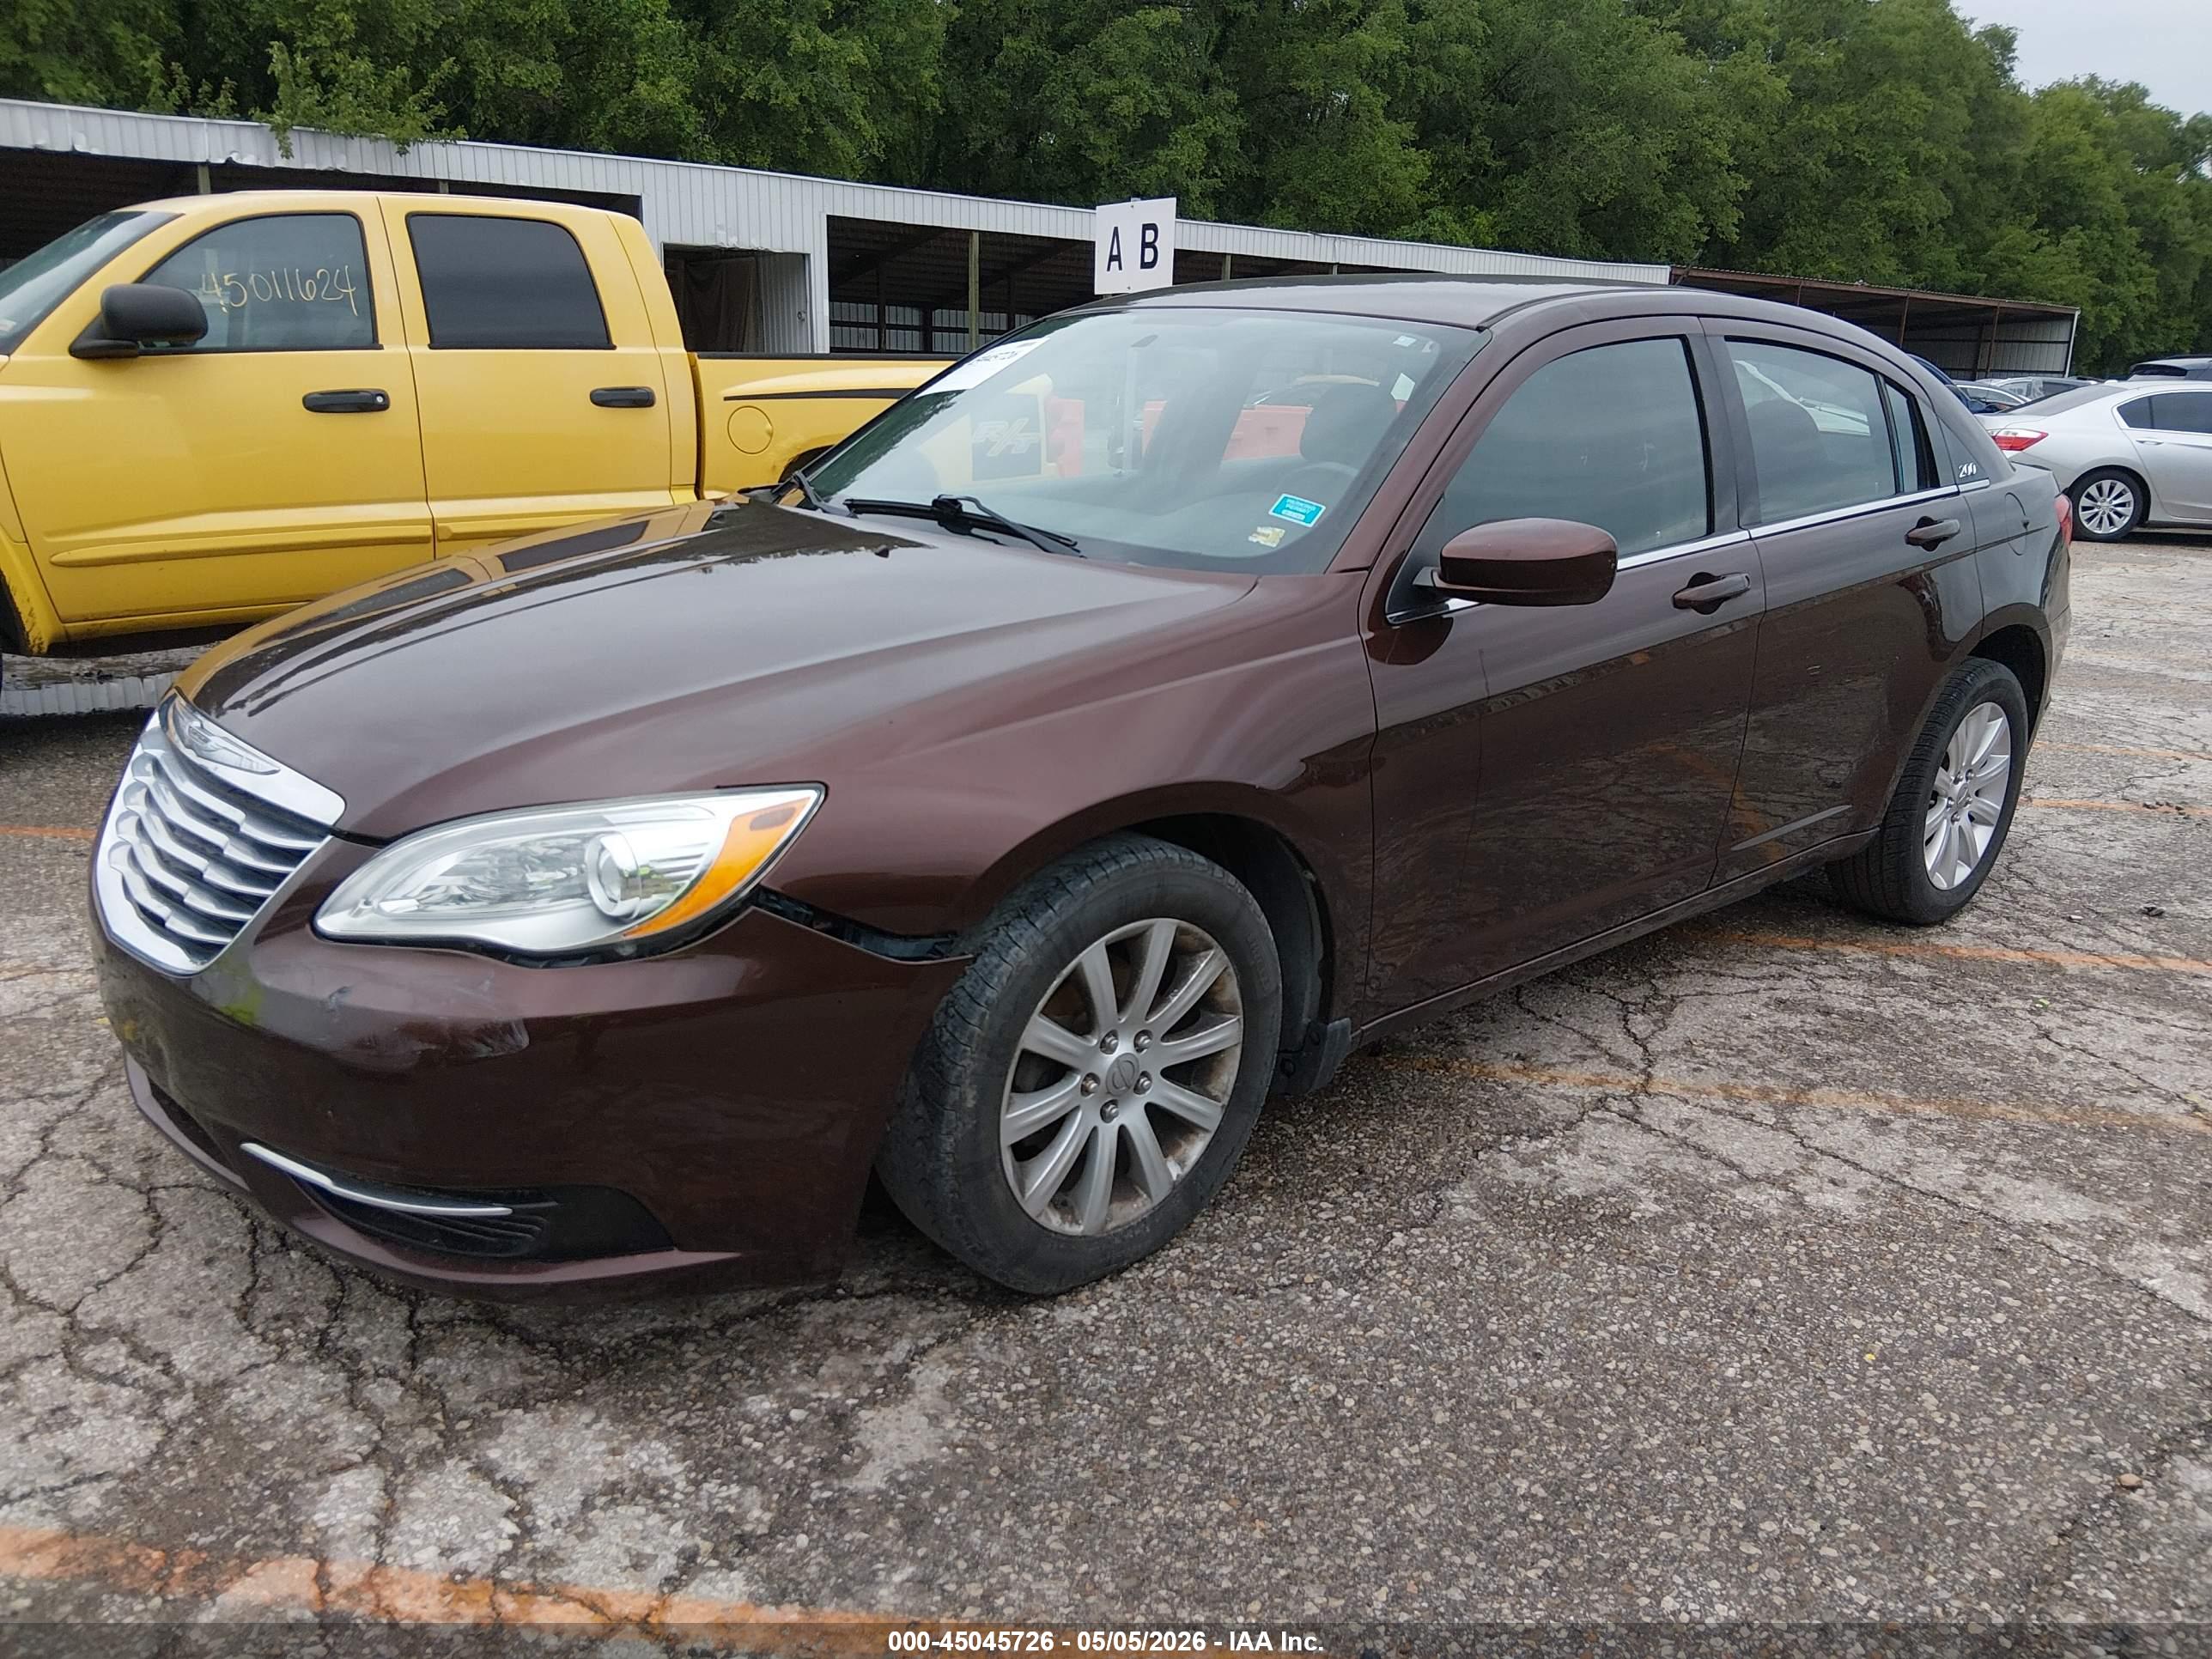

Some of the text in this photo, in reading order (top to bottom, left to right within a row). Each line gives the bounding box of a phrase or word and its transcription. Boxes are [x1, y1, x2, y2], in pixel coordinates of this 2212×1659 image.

[1106, 222, 1159, 272] A B
[200, 264, 359, 317] 45011624
